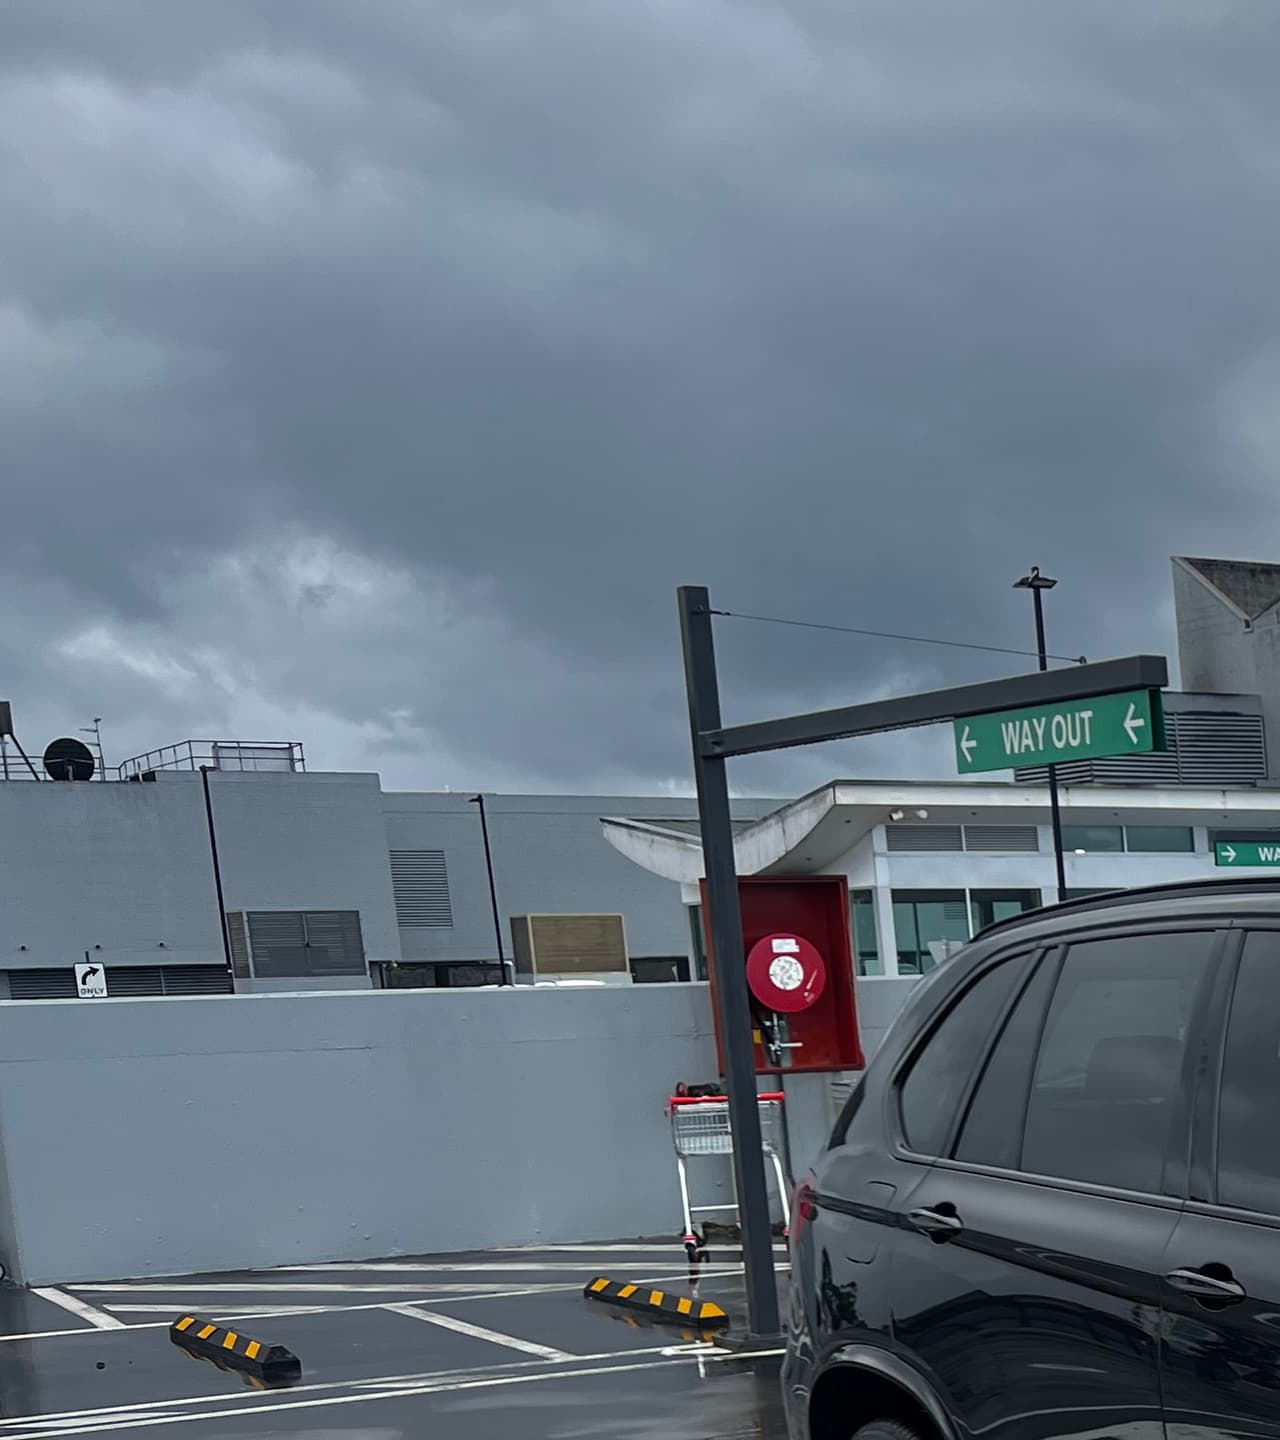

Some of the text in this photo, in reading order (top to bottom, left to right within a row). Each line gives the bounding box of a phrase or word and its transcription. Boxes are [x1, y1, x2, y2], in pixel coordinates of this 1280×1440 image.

[1001, 711, 1093, 755] WAY OUT
[80, 987, 105, 995] ONLY
